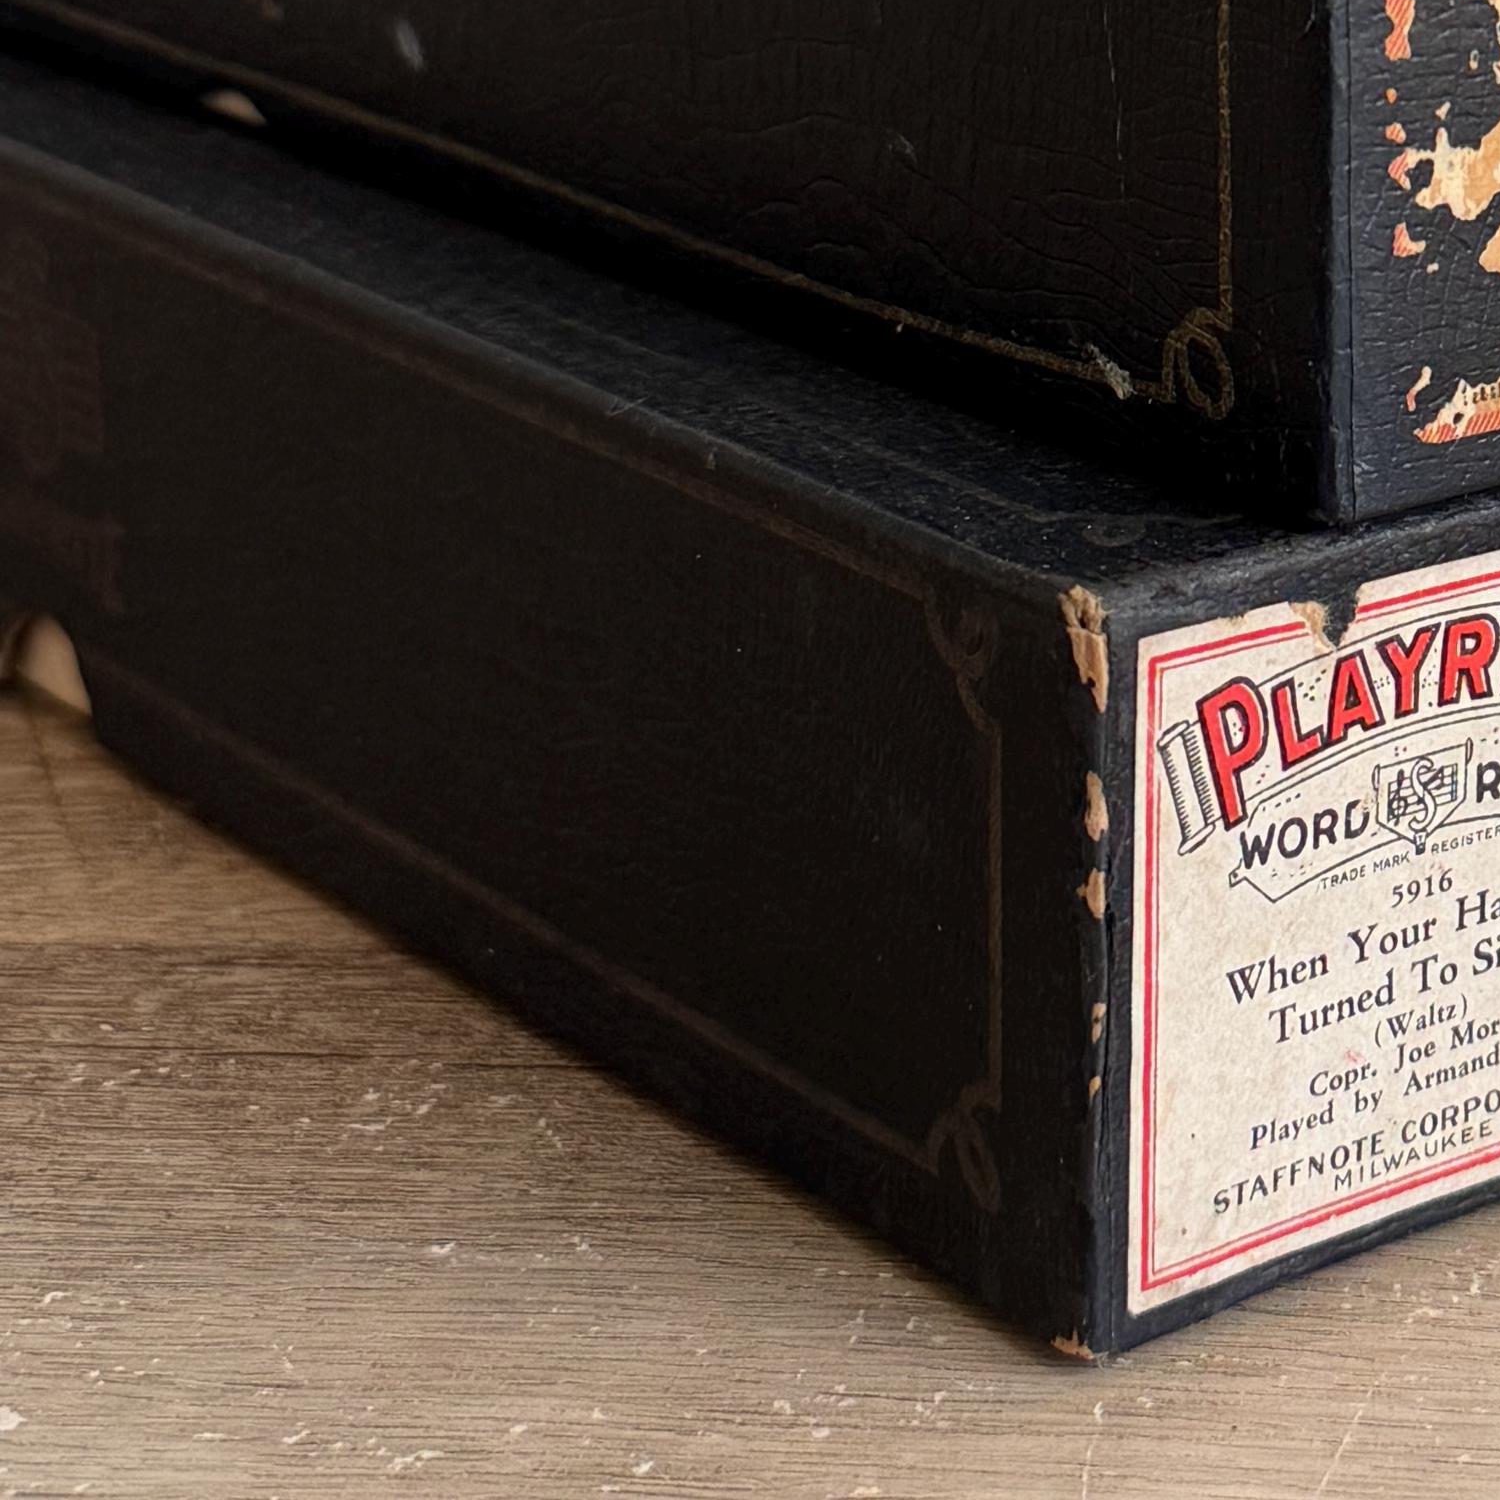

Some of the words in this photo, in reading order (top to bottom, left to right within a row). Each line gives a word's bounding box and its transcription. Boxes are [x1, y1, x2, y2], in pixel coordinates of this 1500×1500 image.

[1240, 801, 1371, 870] WORD
[1319, 867, 1367, 891] TRADE
[1373, 851, 1411, 875] MARK
[1391, 869, 1454, 908] 5916
[1226, 951, 1329, 1005] When
[1348, 917, 1438, 965] Your
[1269, 968, 1395, 1043] Turned
[1411, 954, 1458, 993] To
[1374, 994, 1469, 1047] (Waltz)
[1250, 1104, 1335, 1151] Played
[1355, 1086, 1383, 1116] by
[1403, 1047, 1500, 1098] Armand
[1309, 1063, 1378, 1098] Copr.
[1393, 1040, 1437, 1074] Joe
[1212, 1130, 1384, 1215] STAFFNOTE
[1333, 1119, 1494, 1193] MILWAUKEE
